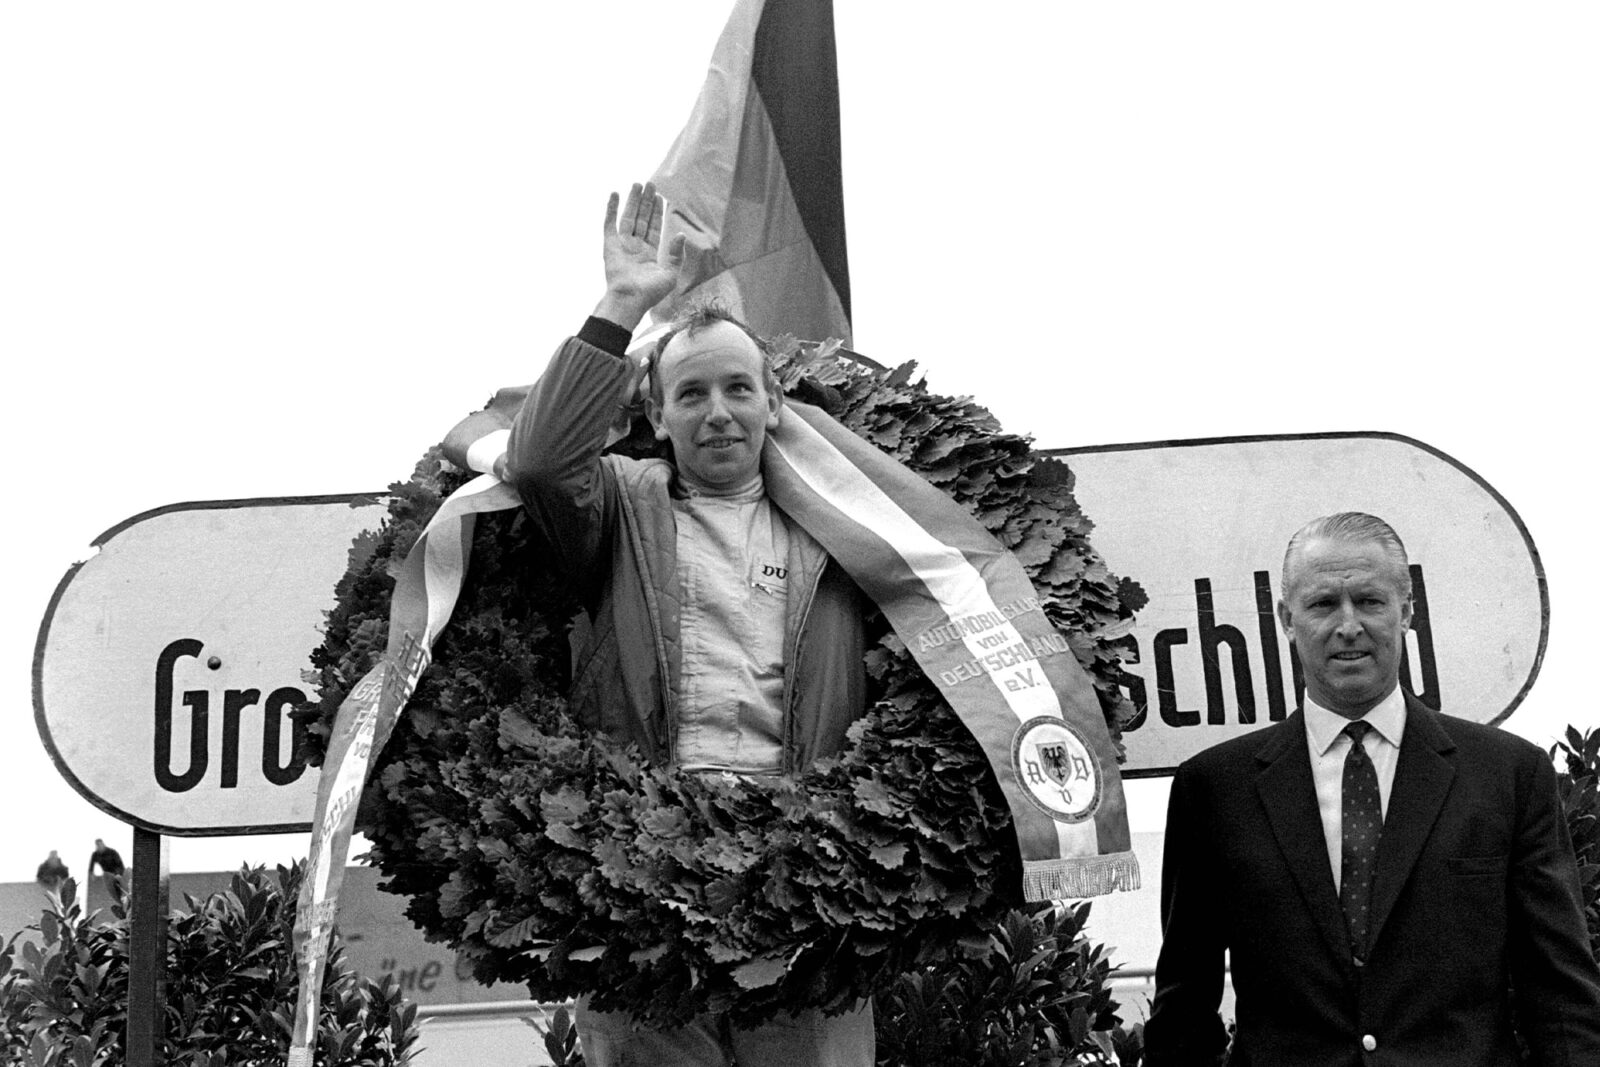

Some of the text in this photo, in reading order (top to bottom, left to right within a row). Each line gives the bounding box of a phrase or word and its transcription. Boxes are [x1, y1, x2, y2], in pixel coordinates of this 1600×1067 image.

[976, 631, 1008, 650] VON
[939, 633, 1070, 686] DEUTSCHLAND
[1004, 668, 1041, 692] e.V.
